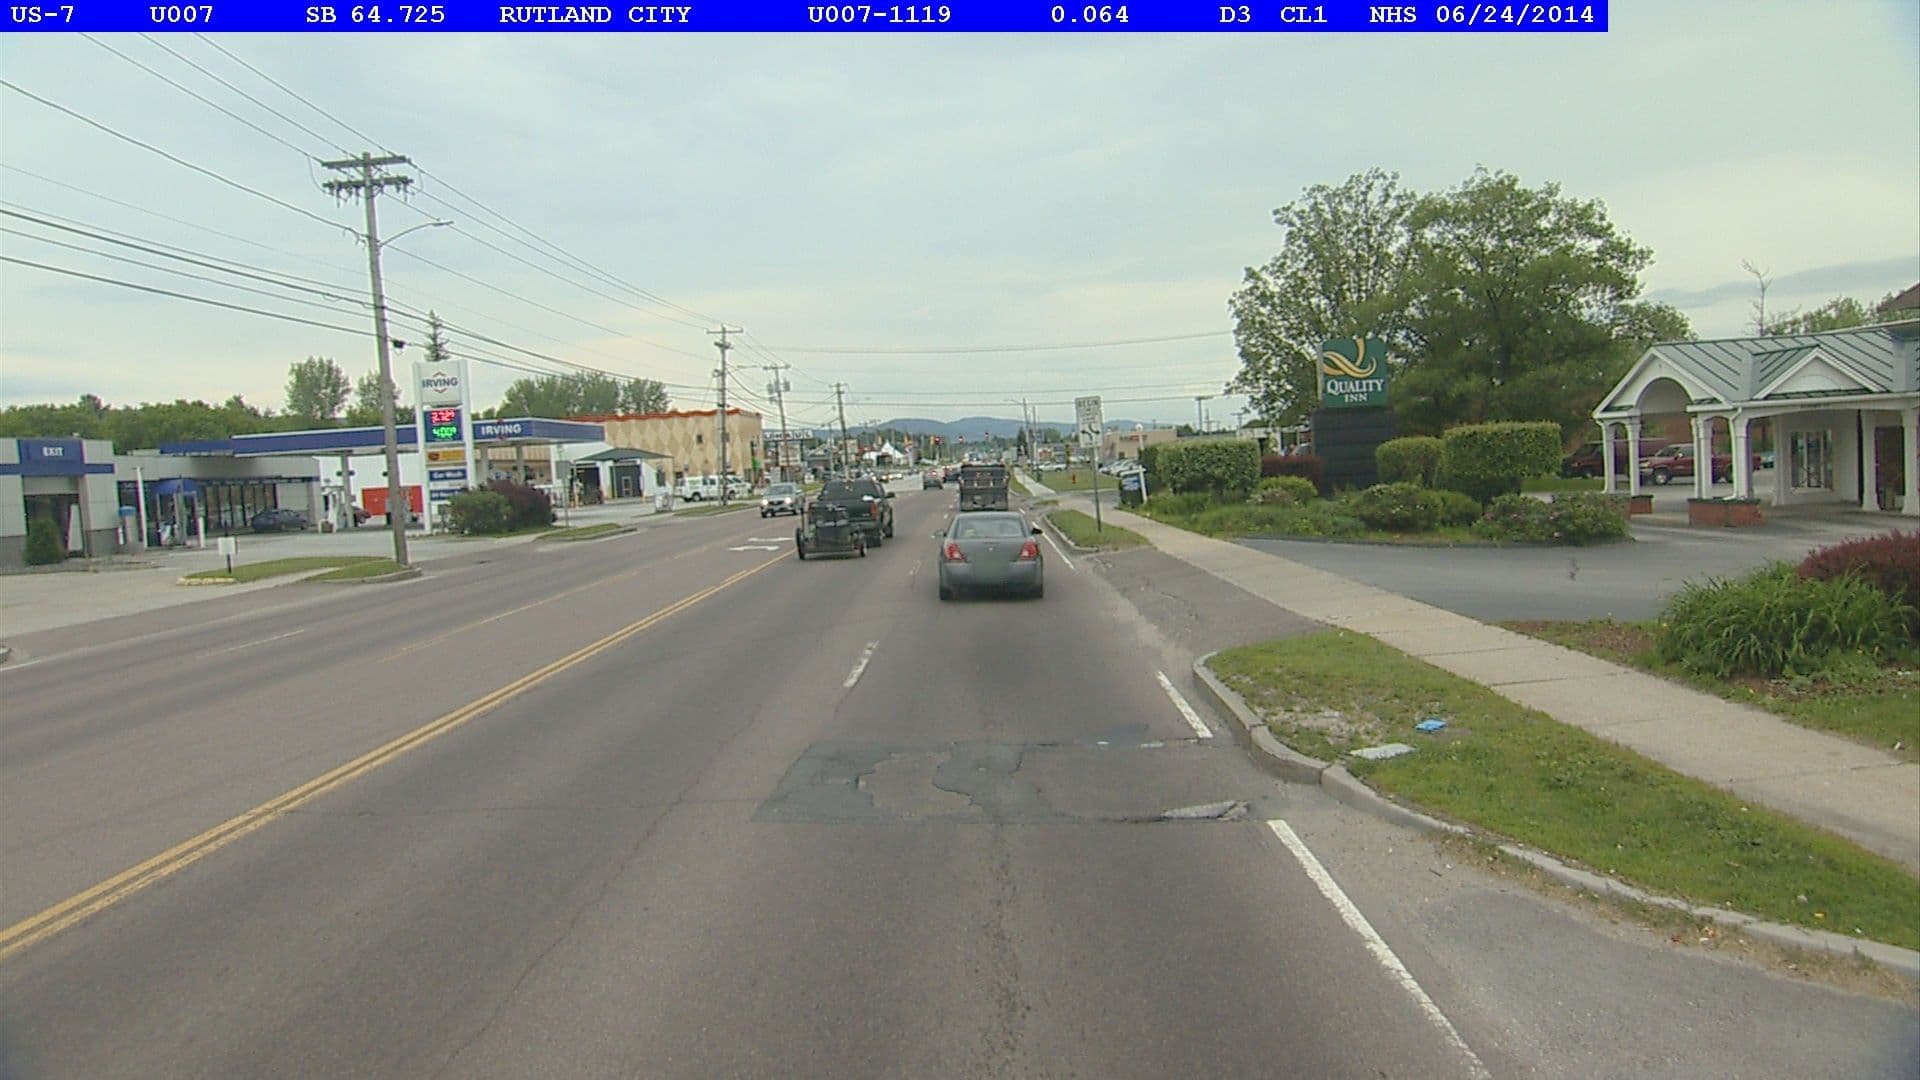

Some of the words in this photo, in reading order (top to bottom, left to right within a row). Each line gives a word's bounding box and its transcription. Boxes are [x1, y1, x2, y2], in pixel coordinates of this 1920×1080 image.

[422, 377, 458, 388] IRVING
[1327, 379, 1384, 396] QUALITY
[1344, 393, 1368, 403] INN
[481, 423, 521, 436] IRVING
[43, 447, 64, 457] EXIT
